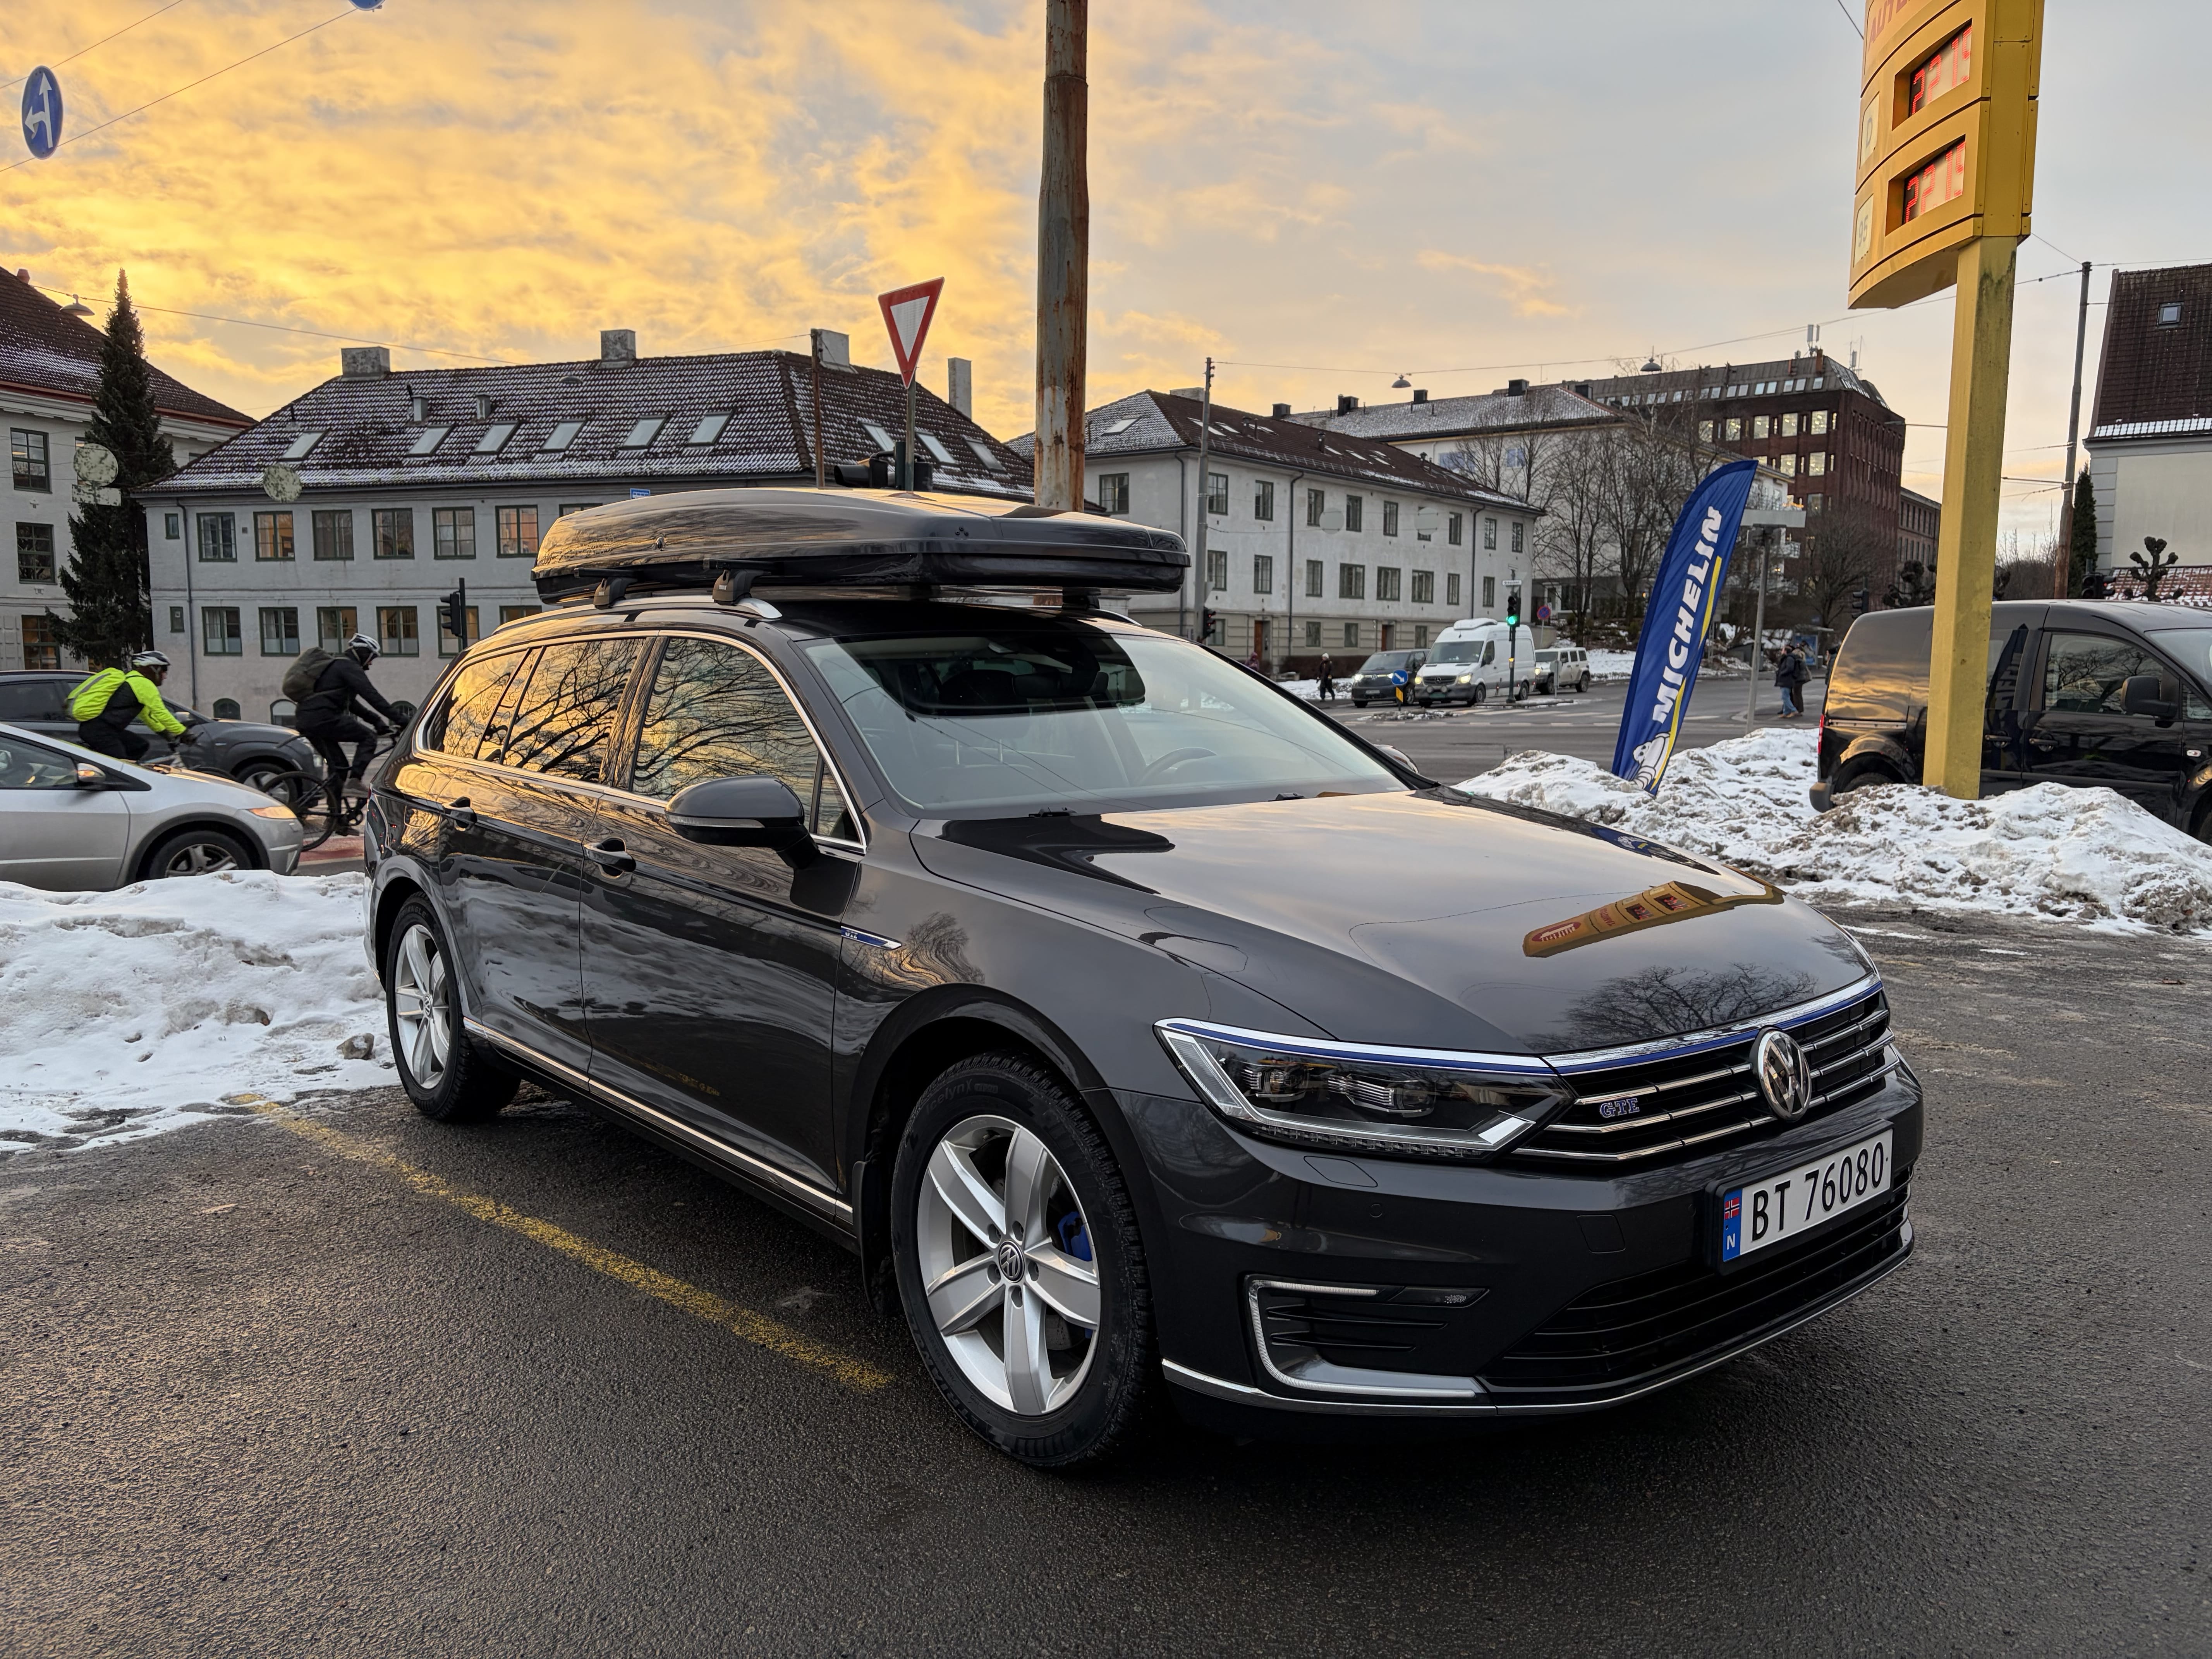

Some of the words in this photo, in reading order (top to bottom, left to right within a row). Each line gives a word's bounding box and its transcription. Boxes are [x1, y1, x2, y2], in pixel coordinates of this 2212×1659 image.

[1865, 117, 1873, 148] D
[1858, 214, 1868, 247] 95
[1652, 506, 1722, 723] MICHELIN
[1600, 1097, 1640, 1118] GTE
[1752, 1180, 1791, 1242] BT
[1805, 1142, 1884, 1221] 76080
[1726, 1233, 1736, 1250] N
